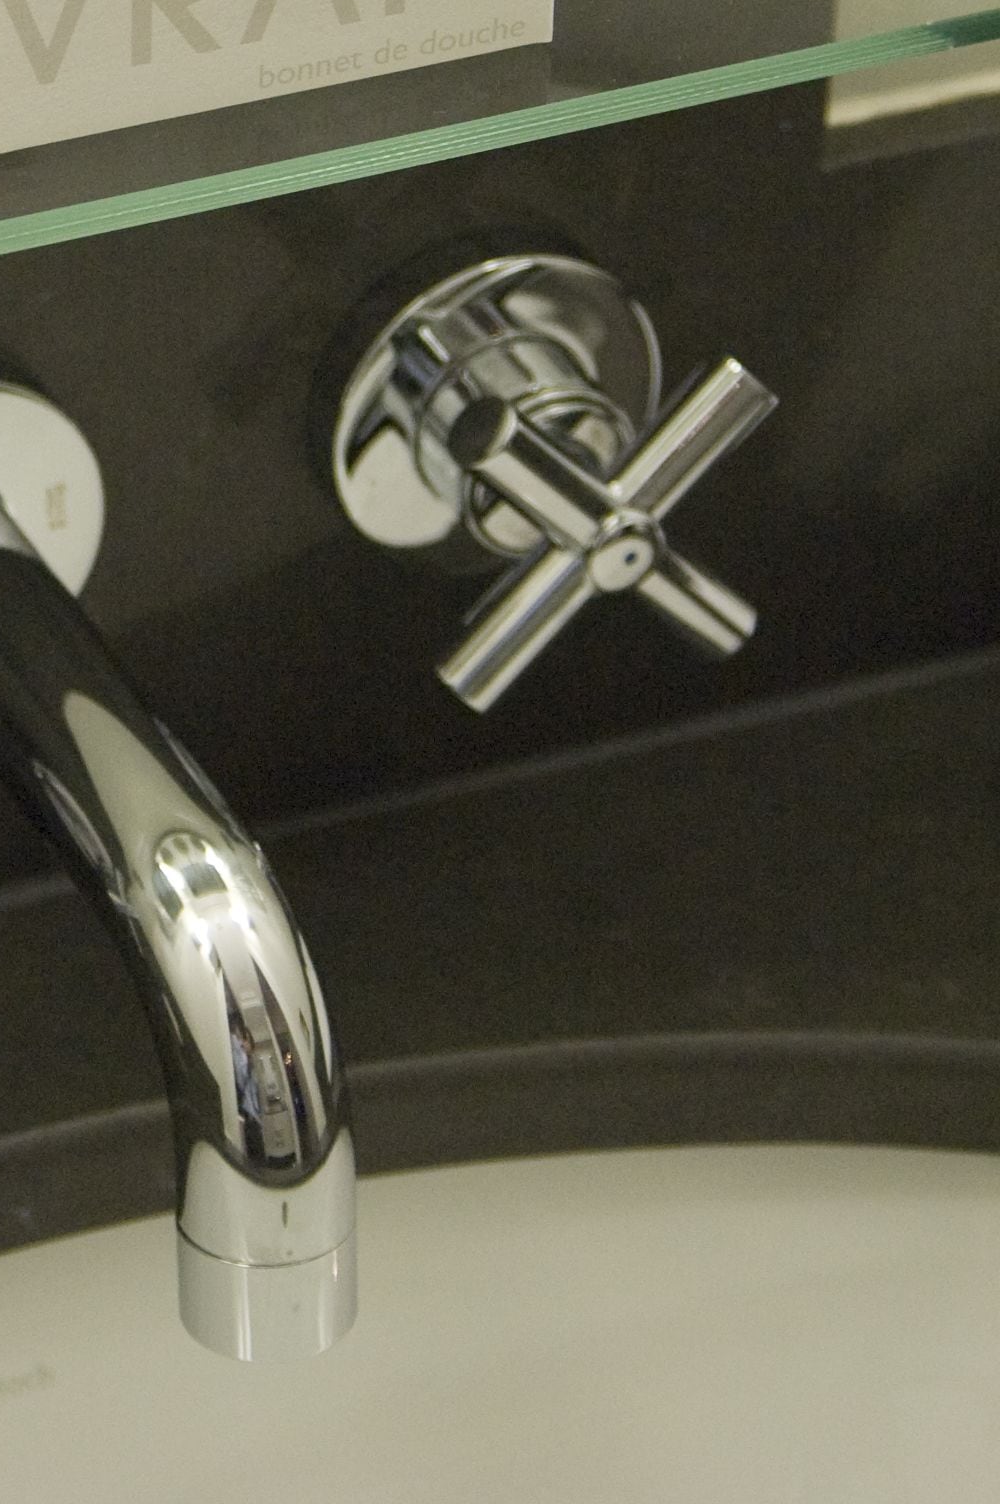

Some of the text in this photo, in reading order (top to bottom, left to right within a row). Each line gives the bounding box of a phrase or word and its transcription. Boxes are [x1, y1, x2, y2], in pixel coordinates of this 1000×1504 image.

[258, 16, 528, 89] bonnet de douche
